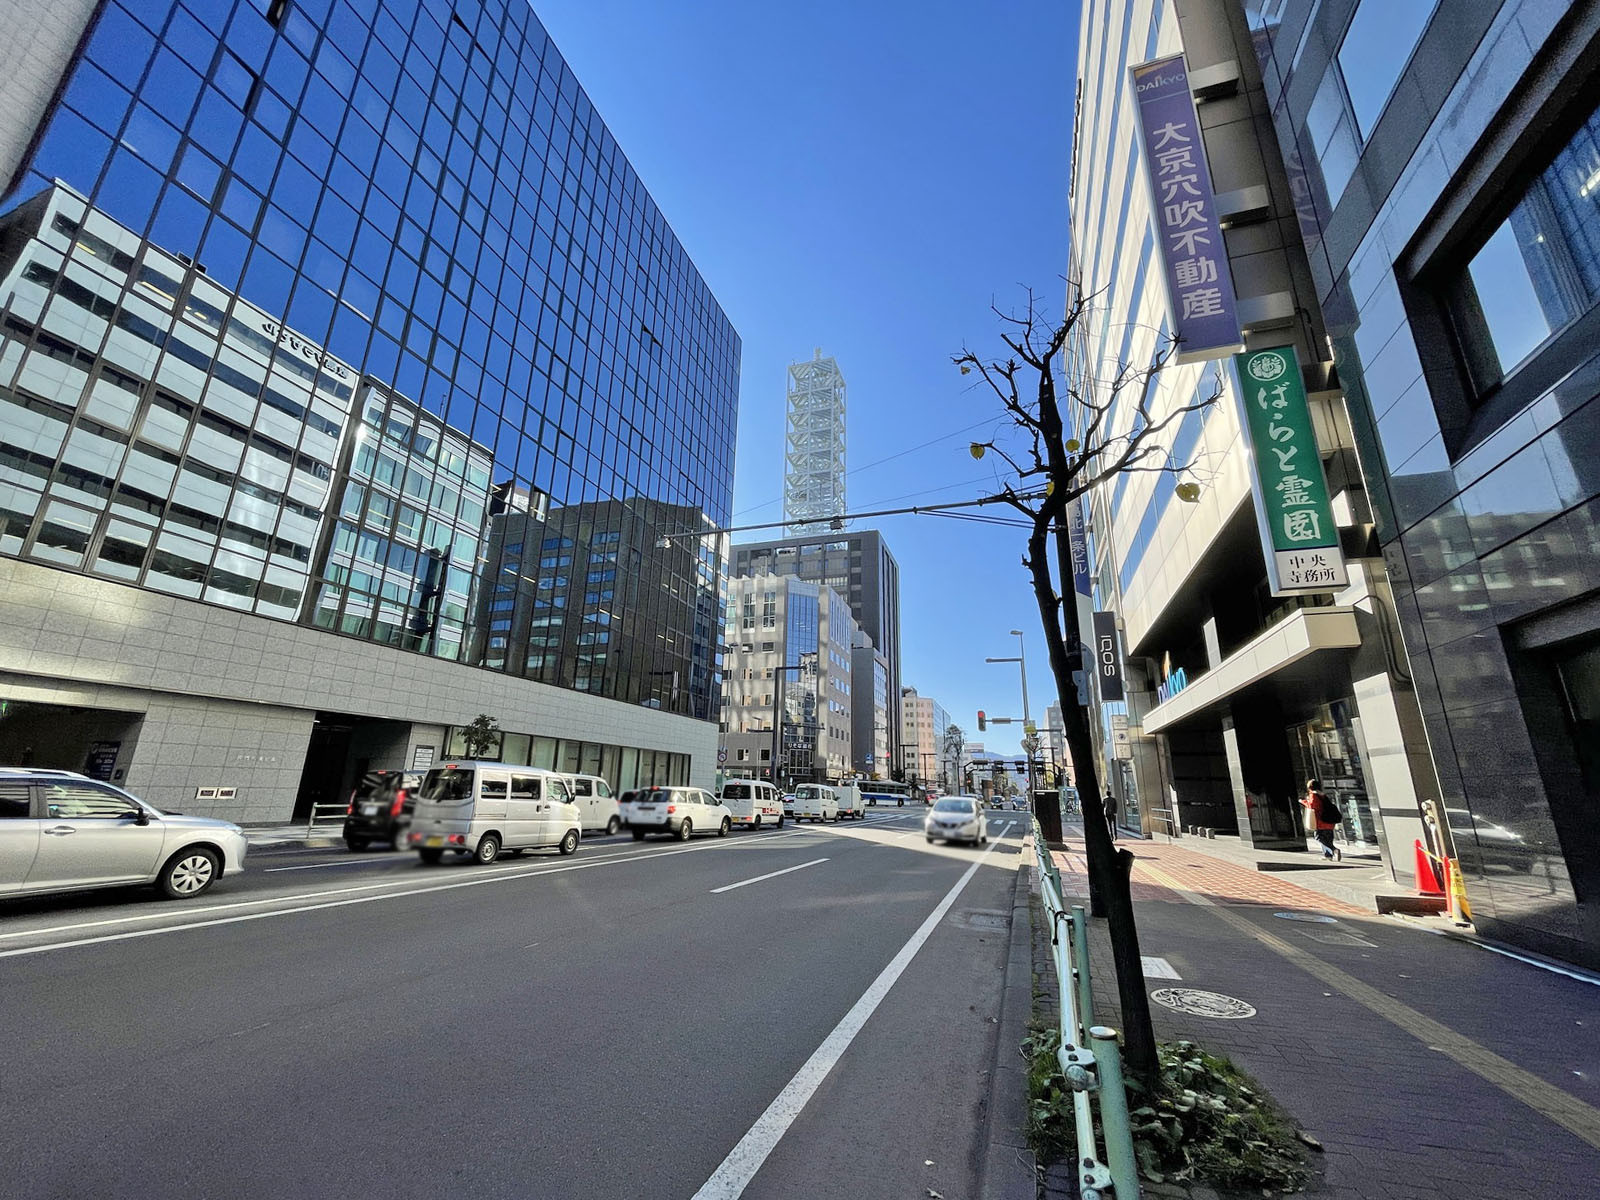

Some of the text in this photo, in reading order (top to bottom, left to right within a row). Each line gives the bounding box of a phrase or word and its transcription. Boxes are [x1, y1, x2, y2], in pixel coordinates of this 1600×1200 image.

[1152, 122, 1225, 321] 大京穴吹不動産
[1257, 382, 1322, 543] ばらと霊園
[1290, 554, 1326, 569] 中央
[1100, 635, 1115, 677] IQOS
